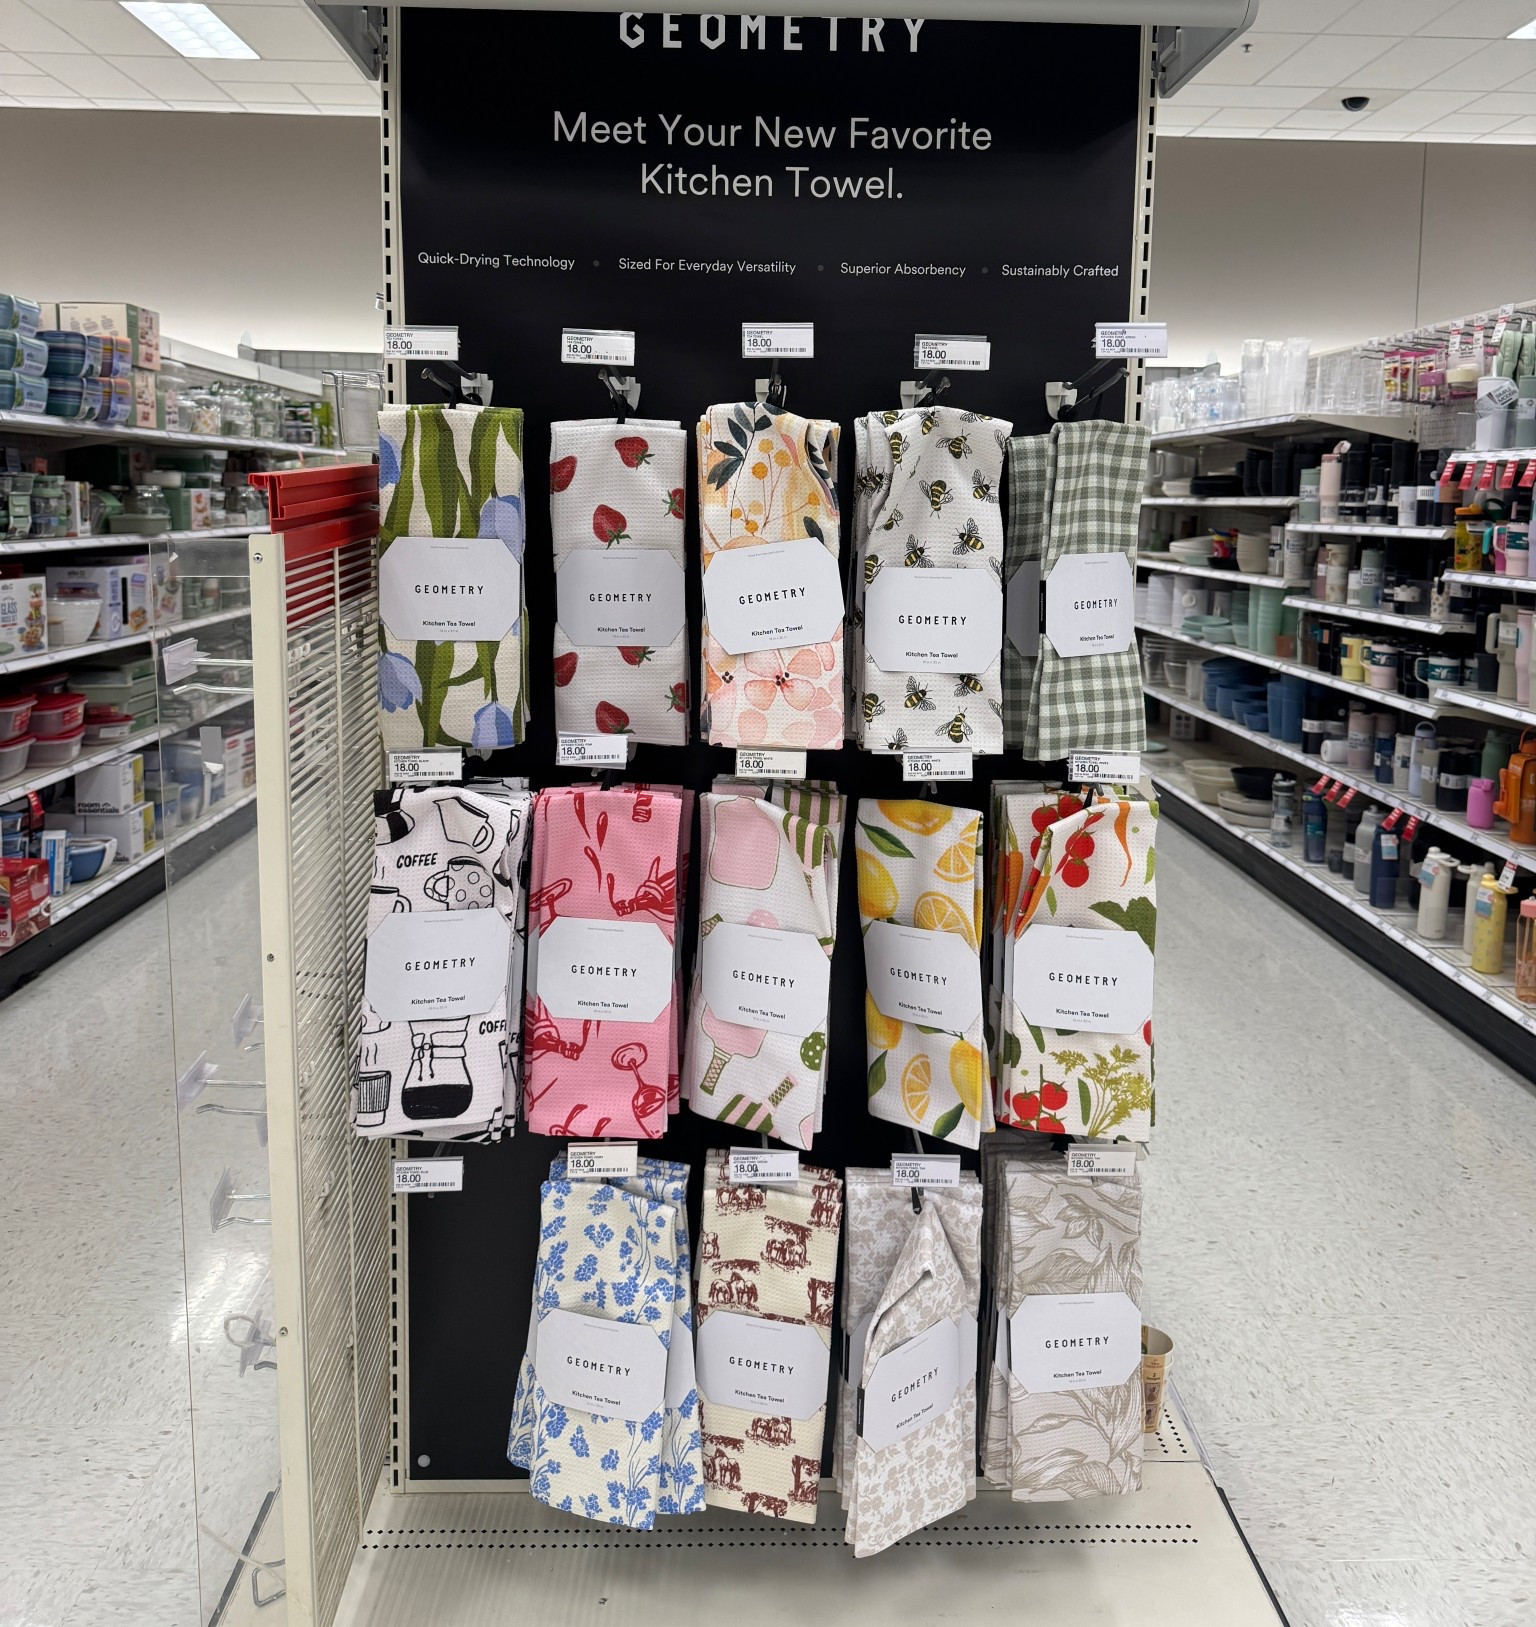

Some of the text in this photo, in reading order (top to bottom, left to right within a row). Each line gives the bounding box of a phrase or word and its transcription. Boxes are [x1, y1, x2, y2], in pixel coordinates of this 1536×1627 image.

[619, 13, 925, 52] GEOMETRY
[554, 111, 991, 150] Meet Your New Favorite
[642, 163, 902, 198] Kitchen Towel.
[418, 252, 575, 270] Quick-Drying Technology
[619, 258, 796, 275] Sized For Everyday Versatility
[841, 263, 966, 277] Superior Absorbency
[1002, 265, 1118, 278] Sustainably Crafted
[387, 341, 412, 349] 18.00
[568, 344, 592, 353] 18.00
[748, 338, 771, 347] 18.00
[1102, 339, 1125, 347] 18.00
[923, 350, 946, 358] 18.00
[414, 584, 484, 595] GEOMETRY
[739, 587, 805, 605] GEOMETRY
[589, 593, 652, 602] GEOMETRY
[1074, 598, 1118, 610] GEOMETRY
[898, 614, 967, 626] GEOMETRY
[395, 763, 419, 771] 18.00
[1076, 764, 1099, 772] 18.00
[396, 853, 438, 868] COFFEE
[405, 957, 475, 972] GEOMETRY
[571, 964, 637, 978] GEOMETRY
[732, 969, 795, 988] GEOMETRY
[889, 967, 947, 986] GEOMETRY
[1049, 972, 1118, 987] GEOMETRY
[738, 1005, 758, 1014] Kitchen
[770, 1011, 786, 1020] Towel
[898, 1001, 917, 1010] Kitchen
[1045, 1336, 1109, 1349] GEOMETRY
[566, 1356, 631, 1377] GEOMETRY
[729, 1356, 794, 1375] GEOMETRY
[891, 1366, 939, 1404] GEOMETRY
[571, 1390, 592, 1400] Kitchen
[604, 1398, 621, 1406] Towel
[734, 1389, 756, 1398] Kitchen
[768, 1395, 785, 1403] Towel
[896, 1416, 913, 1429] Kitchen
[921, 1402, 934, 1414] Towel
